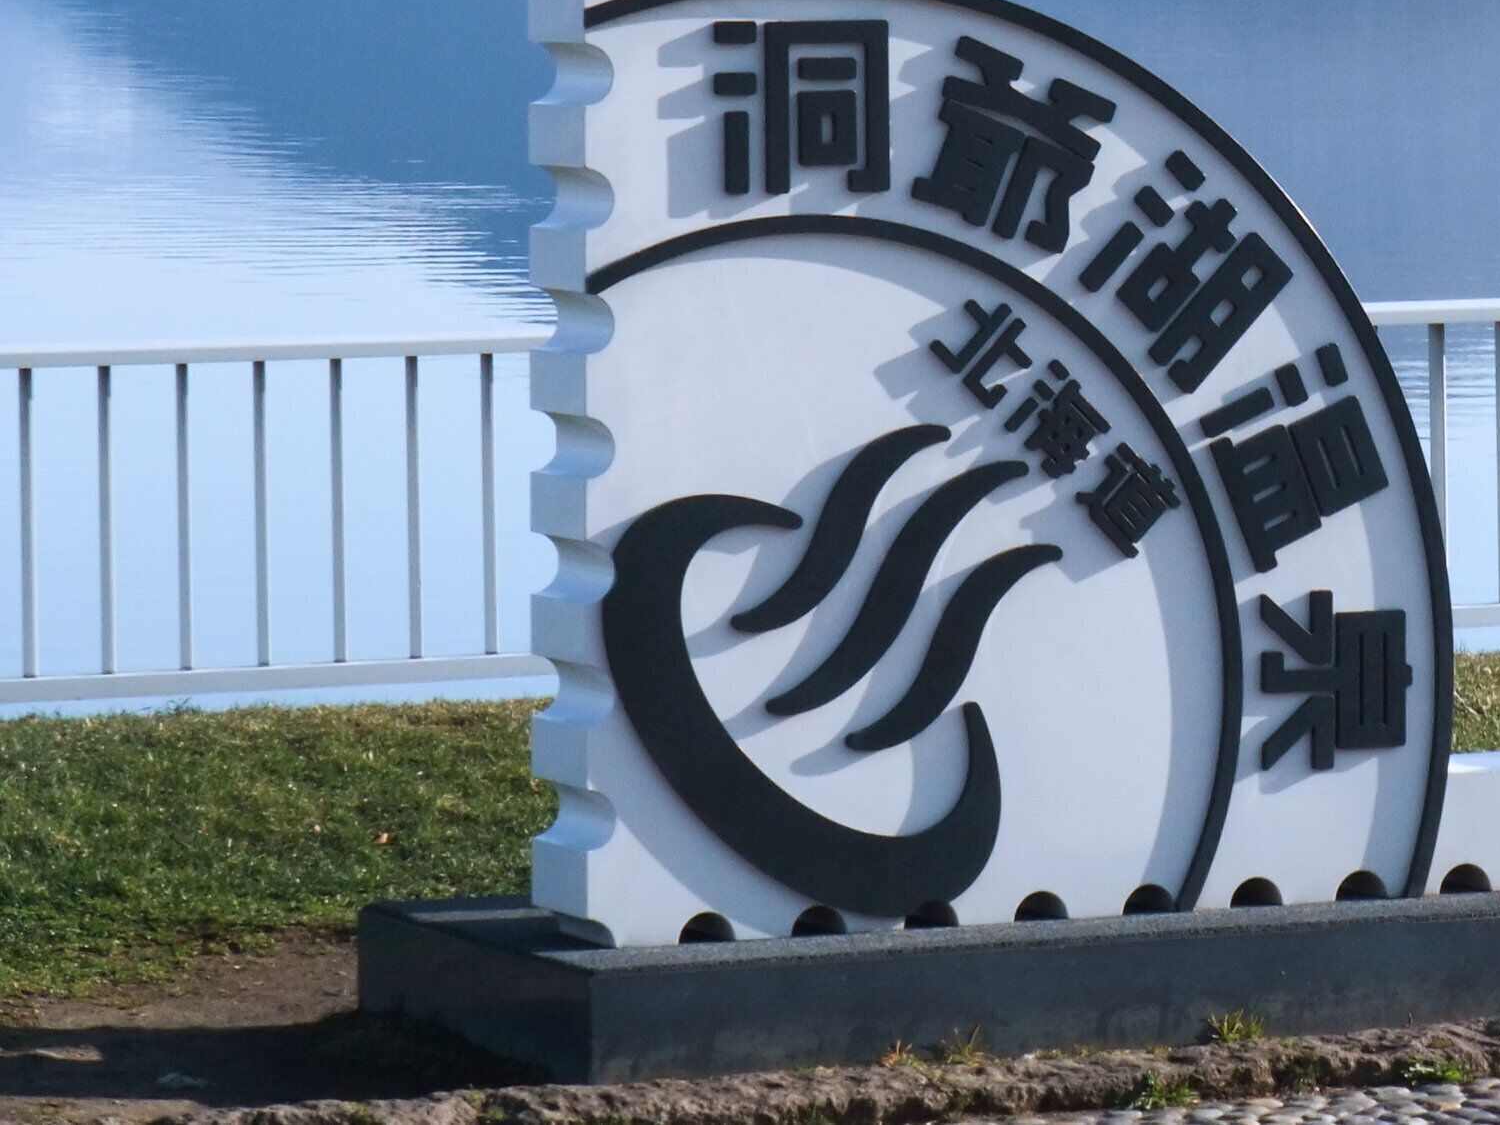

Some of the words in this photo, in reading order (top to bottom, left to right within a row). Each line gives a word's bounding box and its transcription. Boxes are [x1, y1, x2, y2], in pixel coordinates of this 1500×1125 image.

[713, 18, 1413, 771] 洞爺湖温泉
[930, 298, 1181, 558] 北海道
